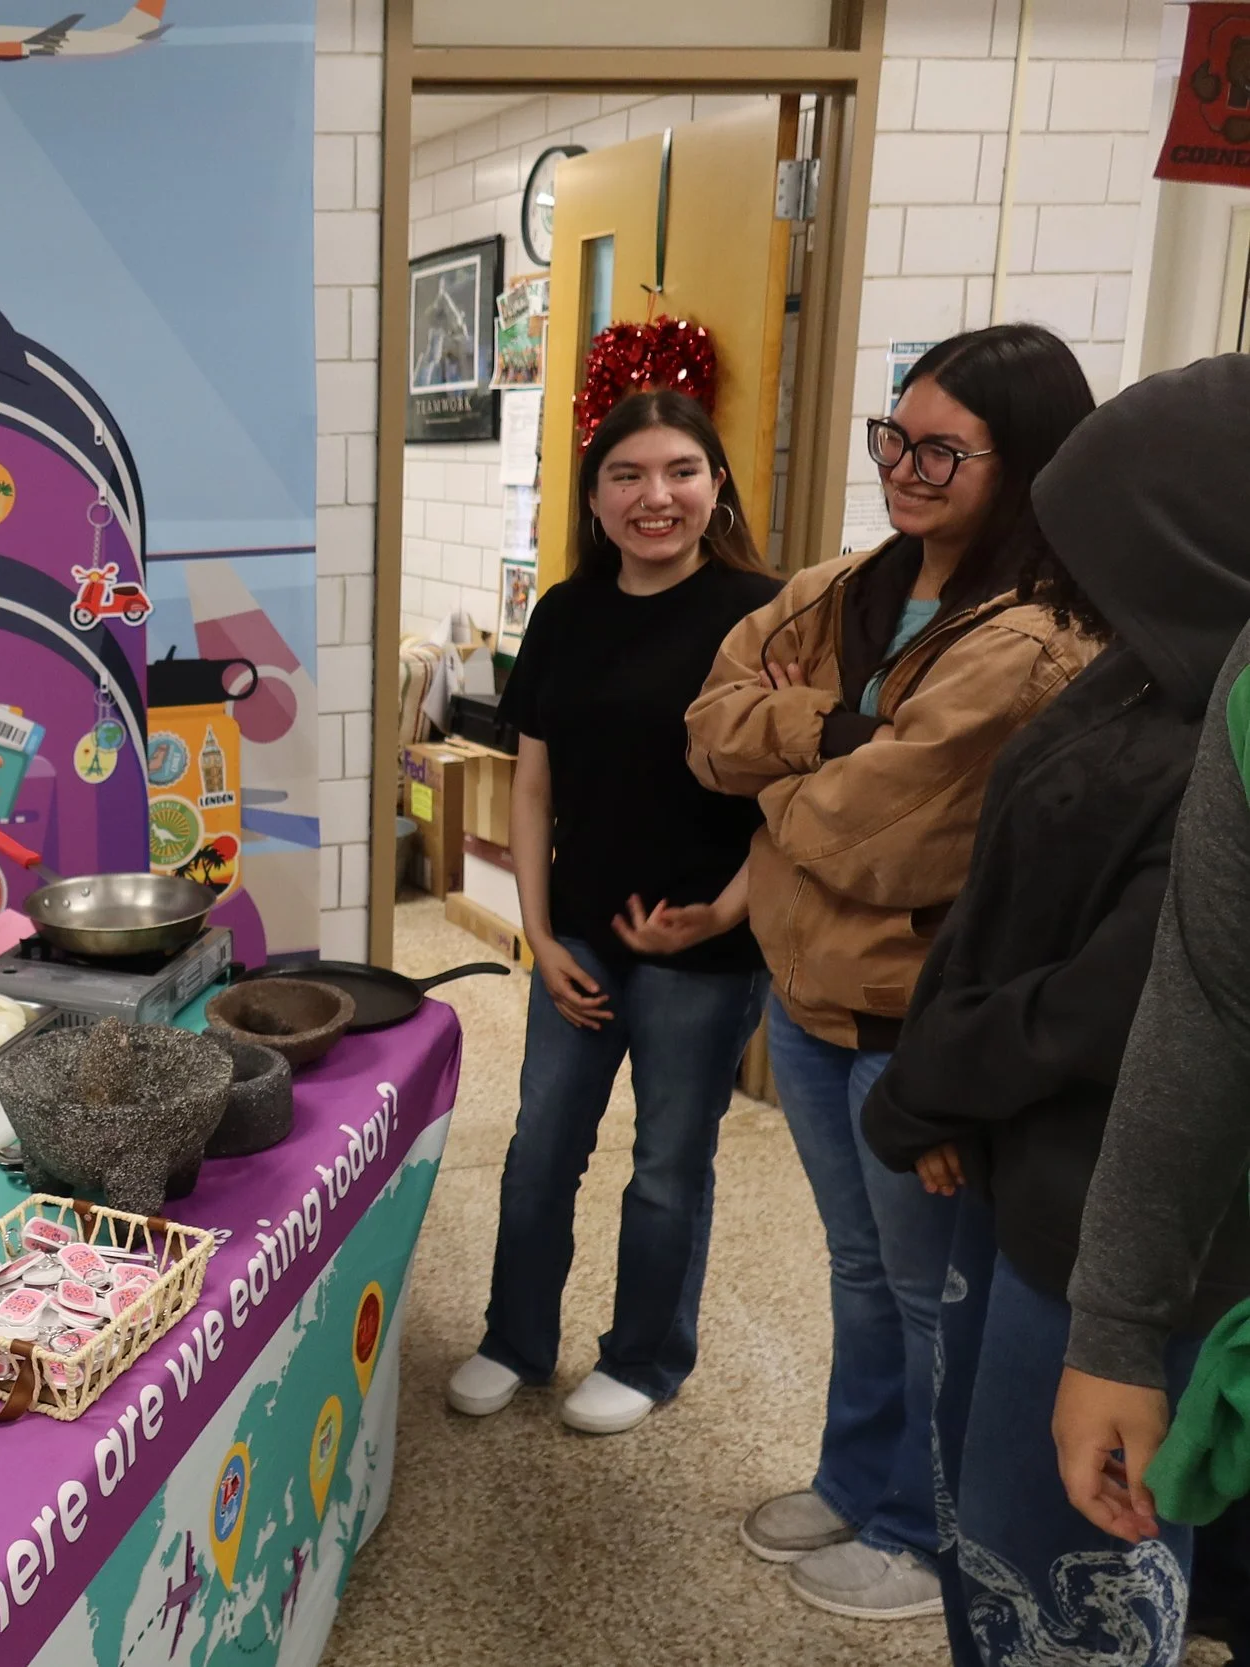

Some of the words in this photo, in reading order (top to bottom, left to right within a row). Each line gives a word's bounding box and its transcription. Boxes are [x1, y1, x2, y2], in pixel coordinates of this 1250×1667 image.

[415, 397, 472, 415] TEAMWORK
[199, 794, 234, 807] LONDON
[94, 1383, 165, 1498] are
[164, 1309, 225, 1403] we
[229, 1187, 322, 1329] eating
[314, 1081, 399, 1211] today?
